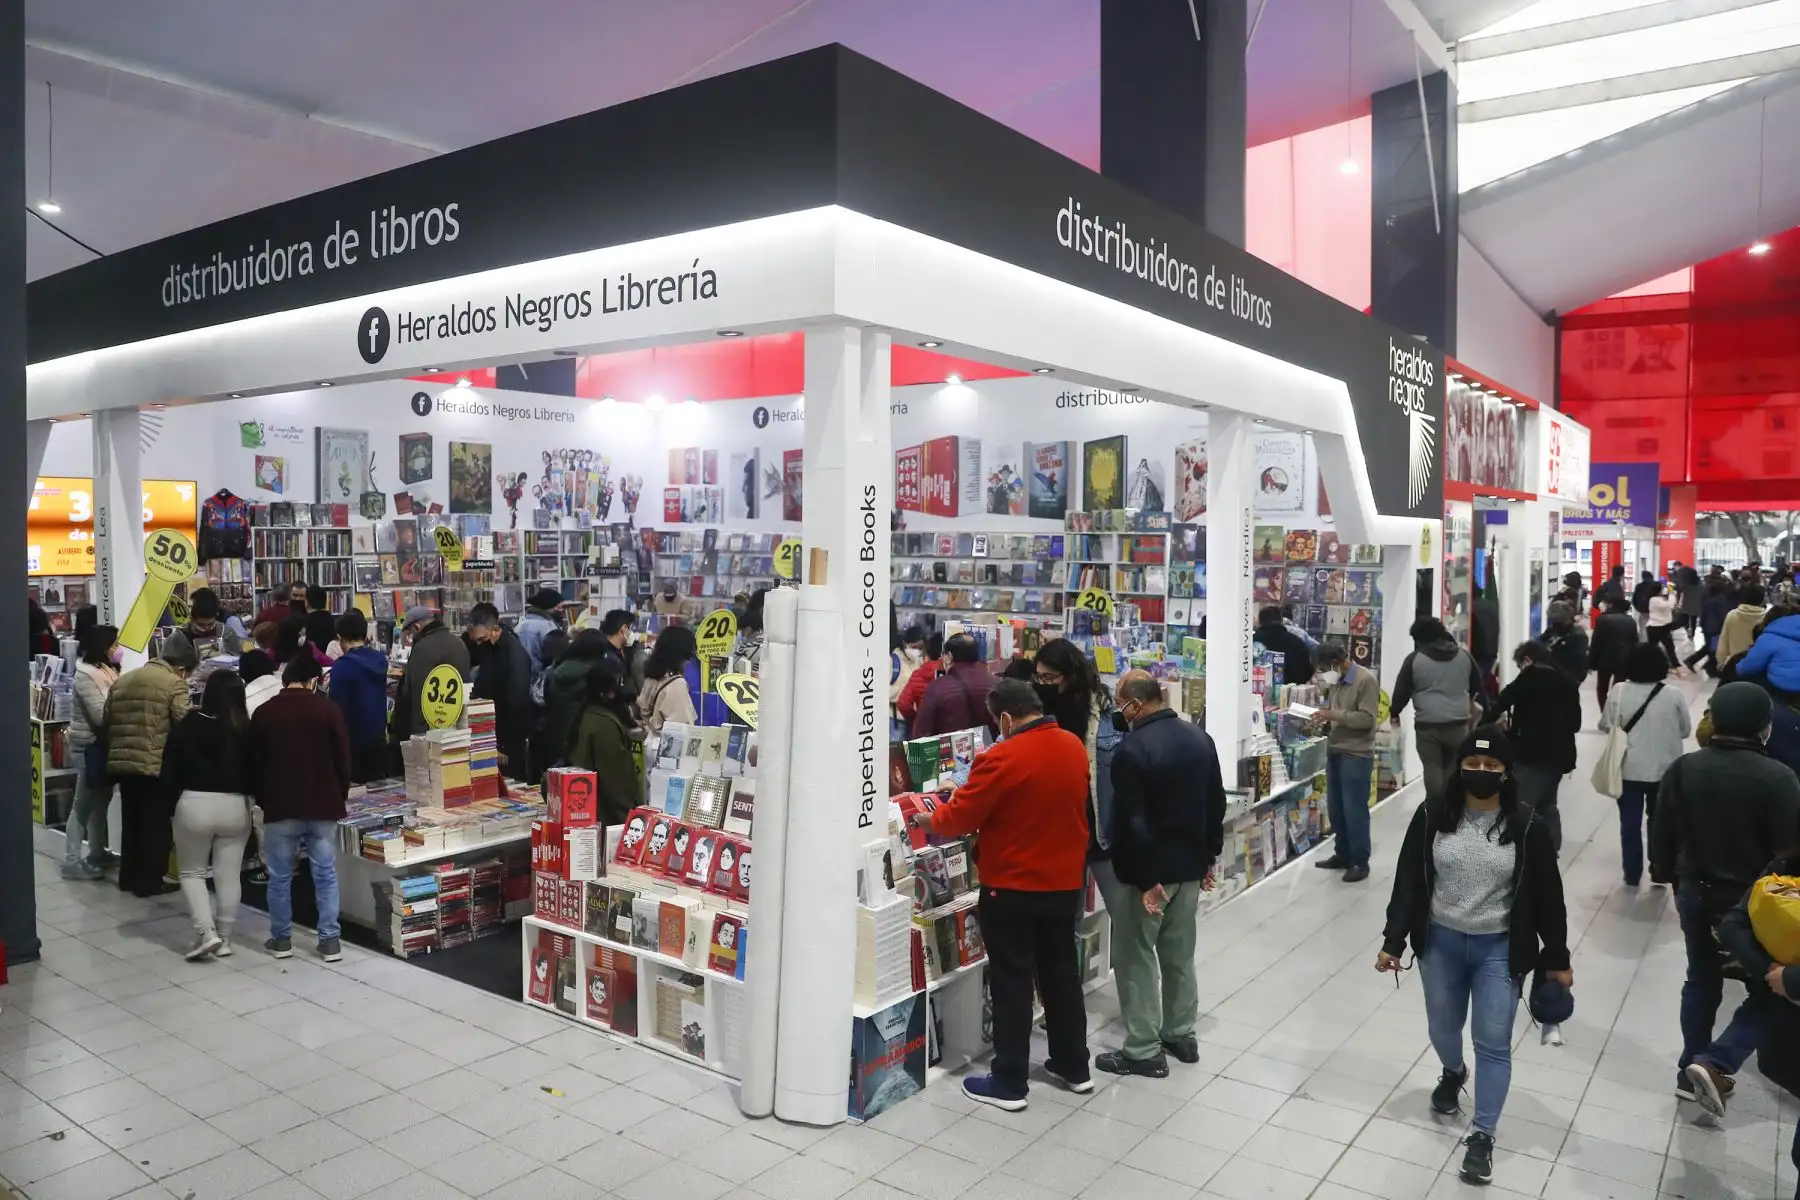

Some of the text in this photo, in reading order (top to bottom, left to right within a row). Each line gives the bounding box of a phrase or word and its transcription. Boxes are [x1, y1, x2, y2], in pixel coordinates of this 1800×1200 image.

[161, 202, 460, 307] distribuidora de libros
[1056, 196, 1272, 328] distribuidora de libros
[398, 301, 497, 343] Heraldos
[505, 289, 592, 332] Negros
[602, 258, 718, 315] Librería
[1389, 336, 1434, 387] heraldos
[436, 398, 490, 416] Heraldos
[493, 404, 531, 420] Negros
[1389, 375, 1425, 416] negros
[860, 484, 877, 562] Books
[1597, 509, 1605, 519] Y
[148, 556, 184, 577] descuento
[859, 571, 875, 638] Coco
[858, 665, 877, 829] Paperblanks
